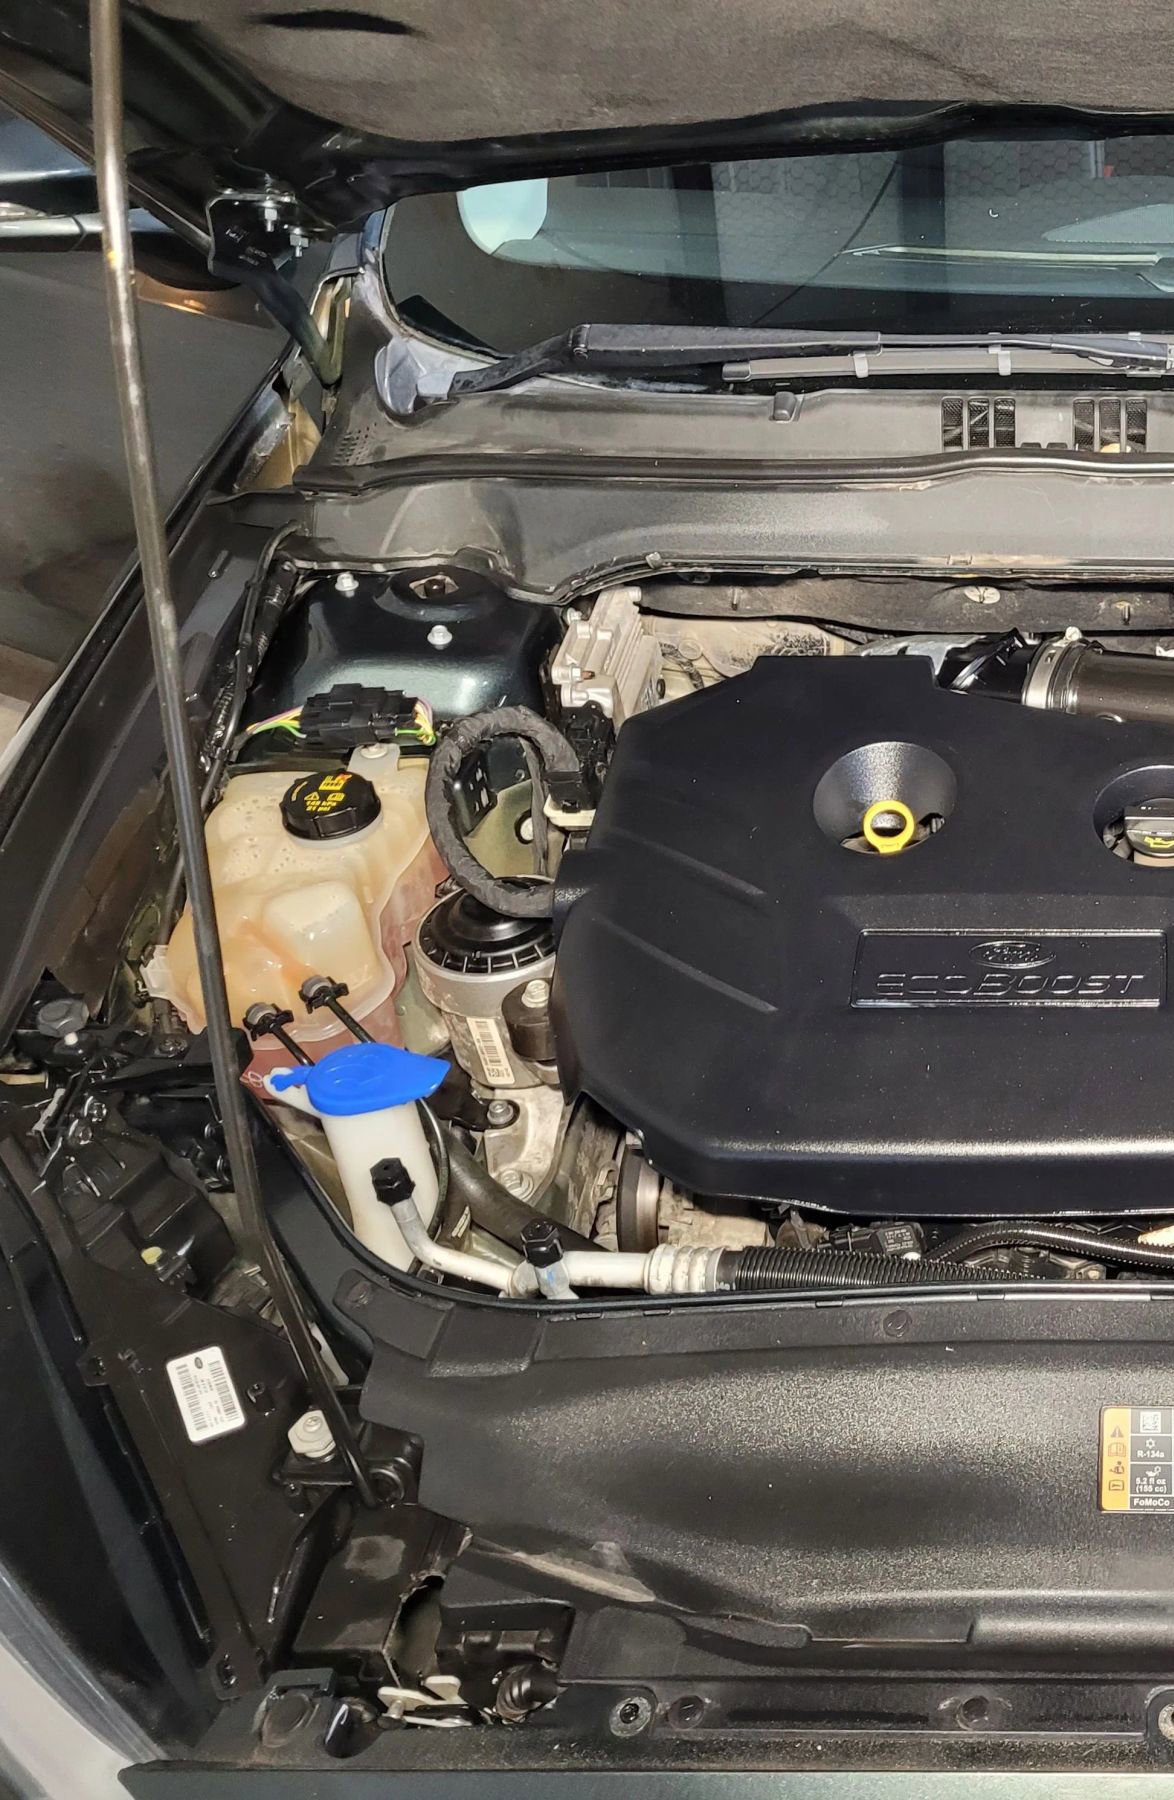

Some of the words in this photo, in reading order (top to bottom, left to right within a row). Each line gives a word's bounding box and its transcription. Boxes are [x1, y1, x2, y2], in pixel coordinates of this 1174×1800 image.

[1137, 1450, 1164, 1458] R-134a
[1136, 1485, 1152, 1493] (155
[1154, 1485, 1167, 1494] cc)
[1134, 1498, 1170, 1506] FoMoCo
